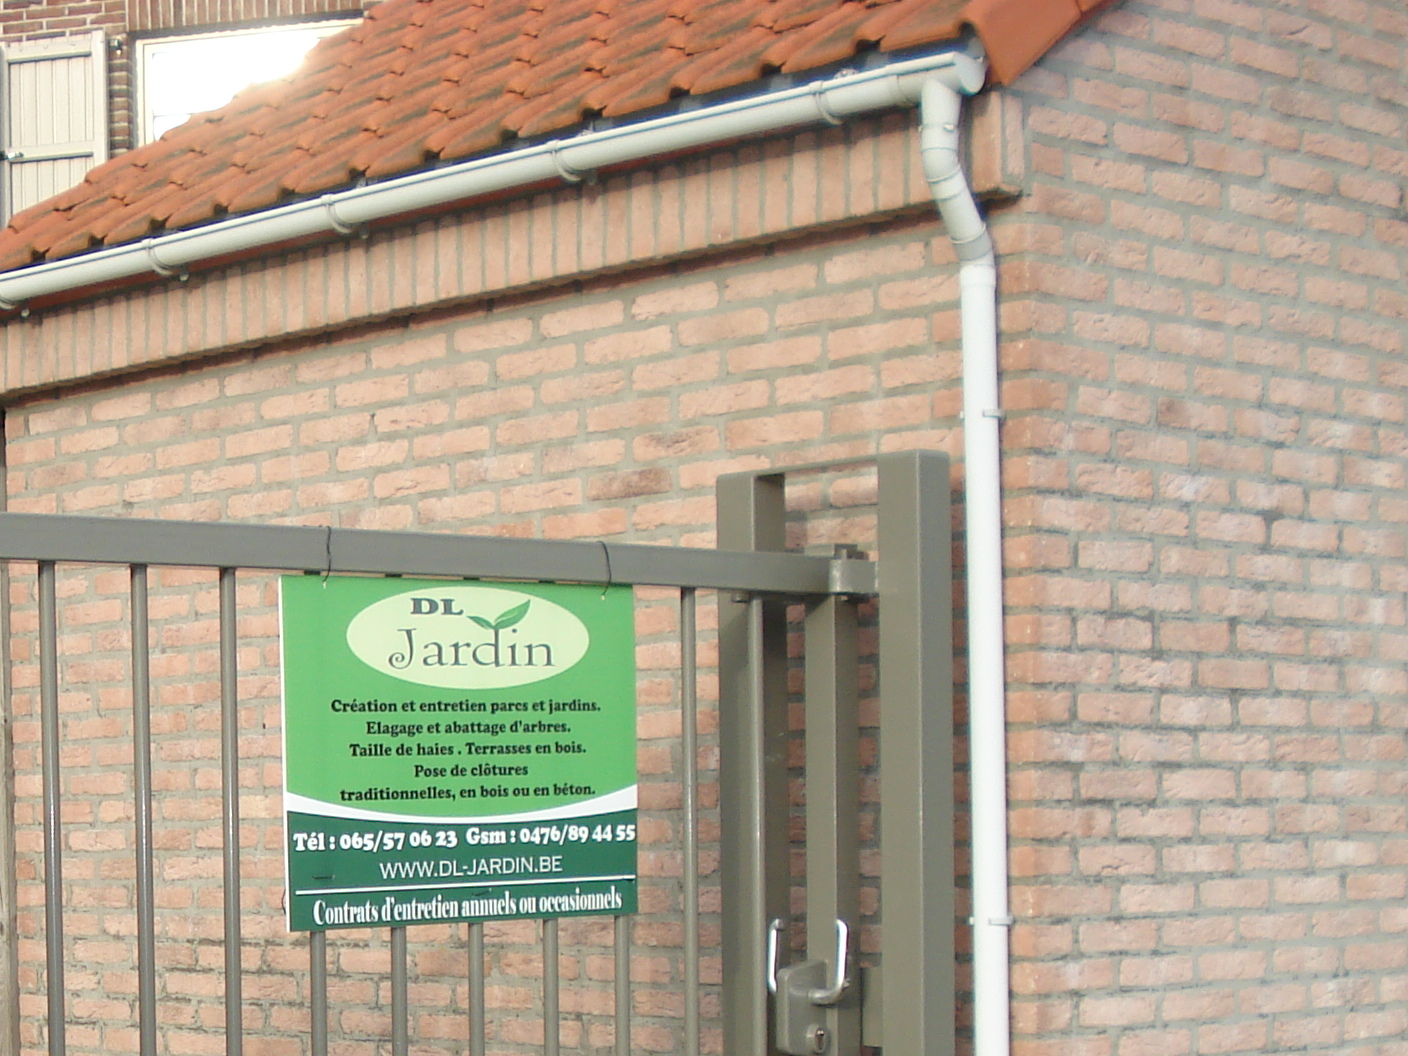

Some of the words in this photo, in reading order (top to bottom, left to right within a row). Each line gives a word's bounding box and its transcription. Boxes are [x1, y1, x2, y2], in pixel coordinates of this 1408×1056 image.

[410, 597, 464, 615] DL
[388, 626, 556, 669] Jardin
[331, 699, 397, 712] Création
[401, 701, 416, 711] et
[419, 700, 487, 711] entretien
[490, 701, 528, 714] parcs
[531, 701, 545, 711] et
[548, 699, 601, 714] jardins.
[366, 721, 423, 737] Elagage
[427, 723, 441, 733] et
[444, 721, 506, 737] abattage
[510, 721, 571, 733] d'arbres.
[349, 744, 392, 756] Taille
[395, 743, 413, 756] de
[416, 743, 454, 755] haies
[465, 743, 532, 755] Terrasses
[535, 744, 551, 754] en
[554, 741, 586, 754] bois.
[414, 765, 447, 777] Pose
[450, 764, 467, 777] de
[471, 764, 528, 776] clôtures
[340, 787, 456, 802] traditionnelles,
[460, 788, 476, 798] en
[480, 785, 509, 798] bois
[512, 787, 530, 797] ou
[533, 786, 550, 796] en
[553, 783, 595, 796] béton.
[293, 832, 325, 851] Tél
[340, 831, 406, 852] 065/57
[410, 831, 432, 847] 06
[435, 830, 458, 846] 23
[466, 828, 506, 846] Gsm
[520, 826, 589, 846] 0476/89
[592, 826, 612, 841] 44
[615, 824, 636, 841] 55
[380, 856, 563, 879] WWW.DL-JARDIN.BE
[313, 898, 378, 926] Contrats
[382, 895, 459, 921] d'entretien
[462, 892, 516, 917] annuels
[520, 896, 536, 914] ou
[539, 885, 622, 912] occasionnels
